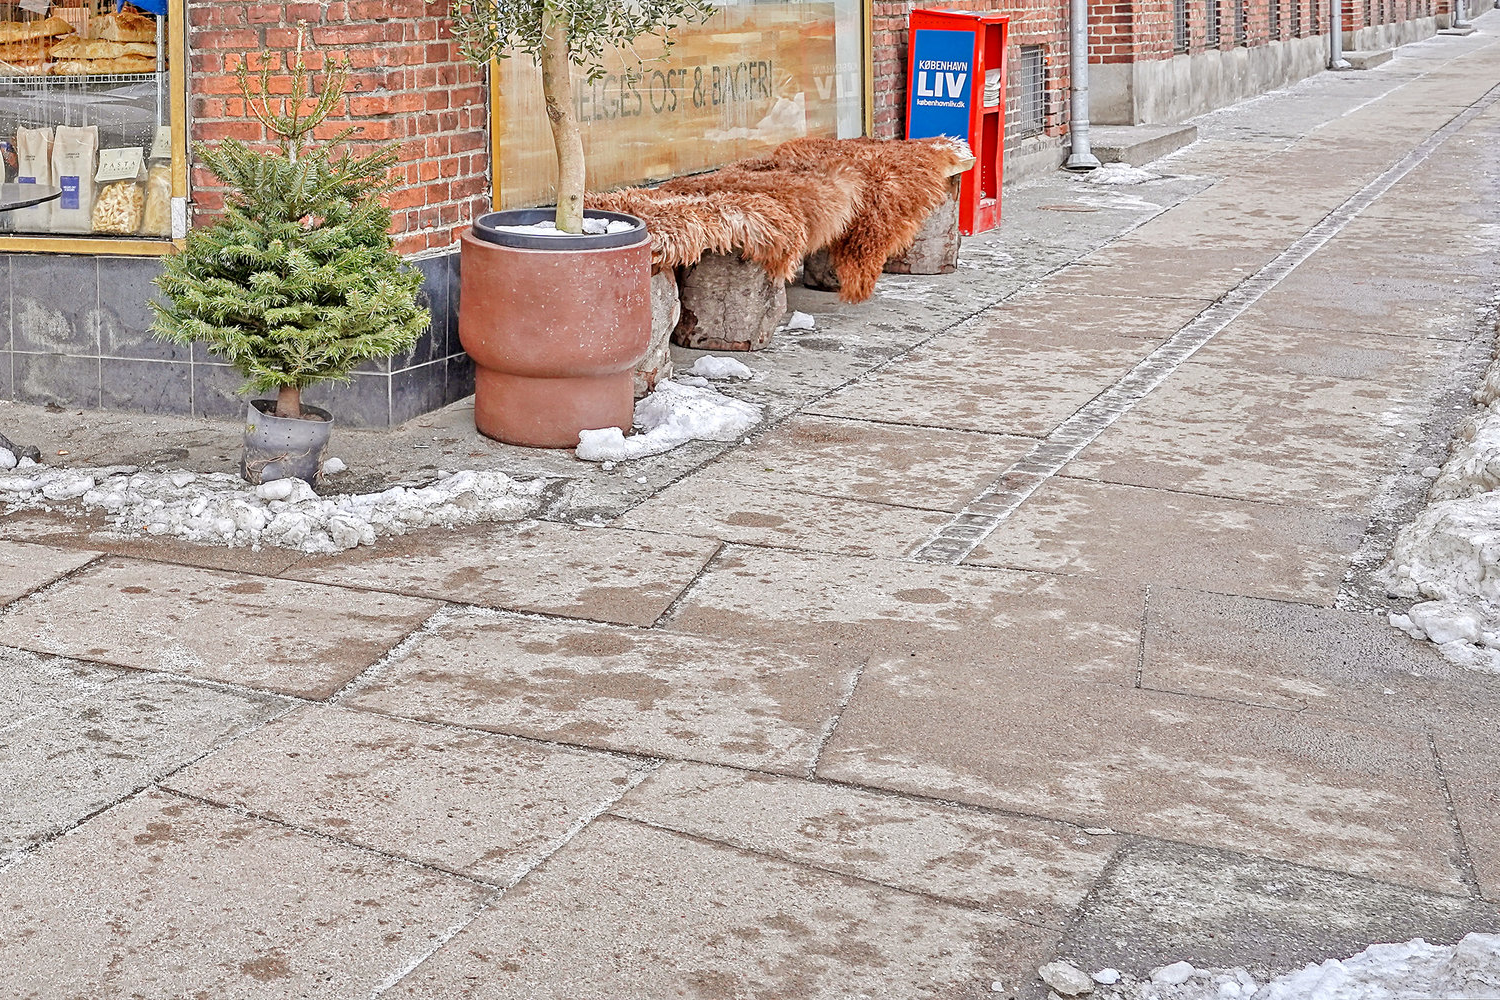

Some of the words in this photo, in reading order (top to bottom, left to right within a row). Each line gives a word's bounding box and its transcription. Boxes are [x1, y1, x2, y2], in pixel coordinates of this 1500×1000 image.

[919, 60, 968, 71] KØBENHAVN
[650, 68, 688, 114] OST
[692, 65, 706, 109] &
[917, 71, 967, 98] LIV
[916, 98, 966, 108] københavnliv.dk
